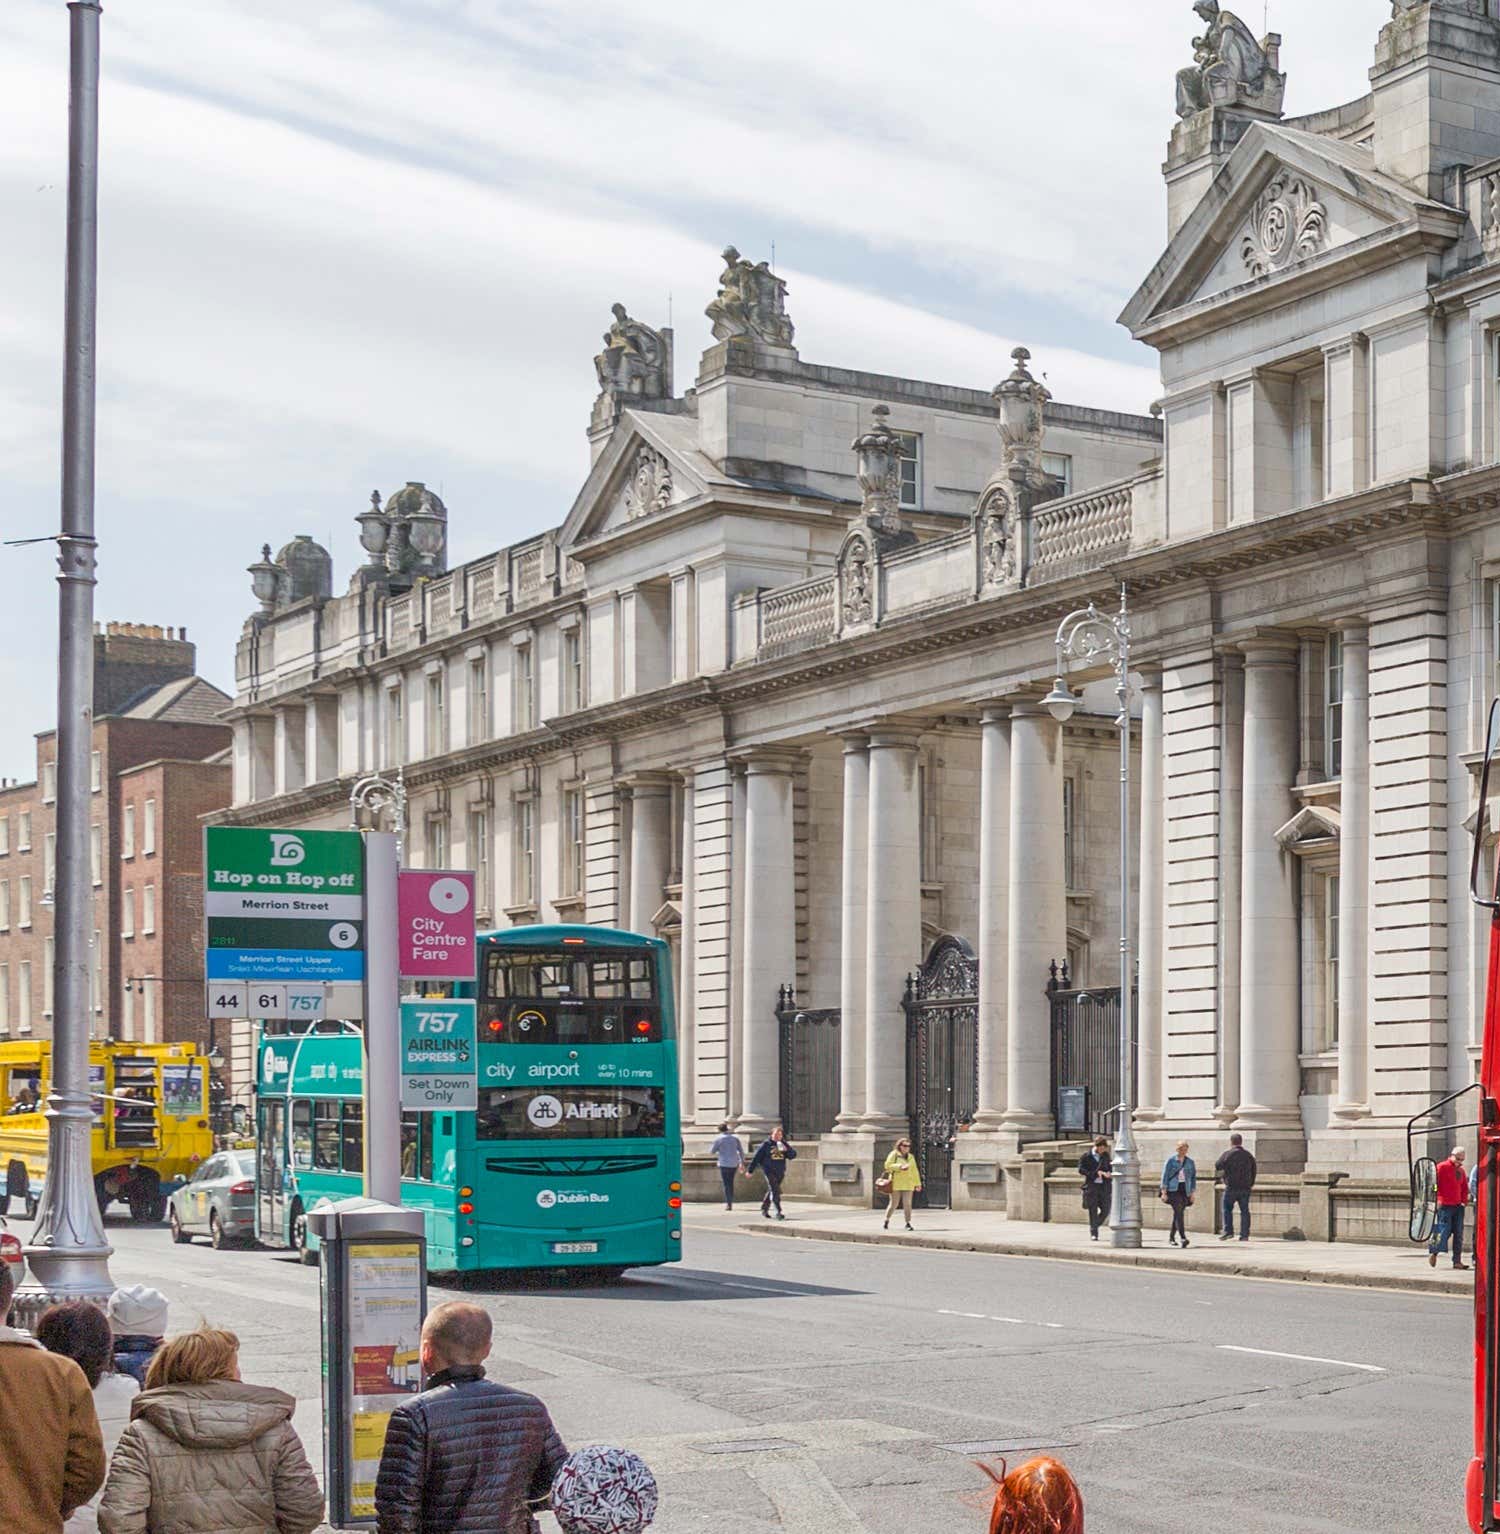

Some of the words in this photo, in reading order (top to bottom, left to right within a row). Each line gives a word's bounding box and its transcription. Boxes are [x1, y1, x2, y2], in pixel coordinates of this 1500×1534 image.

[213, 870, 254, 887] Hop
[257, 874, 282, 885] on
[286, 872, 325, 888] Hop
[328, 874, 355, 887] off
[242, 899, 289, 910] Merrion
[293, 901, 329, 911] Street
[412, 917, 445, 933] City
[339, 930, 349, 941] 6
[412, 932, 467, 946] Centre
[239, 955, 274, 963] Merrion
[276, 955, 303, 963] Street
[305, 956, 333, 965] Upper
[412, 947, 449, 960] Fare
[215, 994, 239, 1008] 44
[258, 994, 278, 1008] 61
[289, 996, 323, 1011] 757
[415, 1012, 459, 1033] 757
[407, 1038, 470, 1051] AIRLINK
[407, 1052, 457, 1062] EXPRESS
[486, 1062, 516, 1080] city
[528, 1062, 580, 1081] airport
[619, 1068, 630, 1078] 10
[631, 1069, 654, 1078] mins
[408, 1079, 430, 1089] Set
[434, 1079, 470, 1089] Down
[425, 1090, 455, 1103] Only
[566, 1102, 620, 1119] Airlink
[557, 1193, 589, 1203] Dublin
[590, 1193, 610, 1203] Bus
